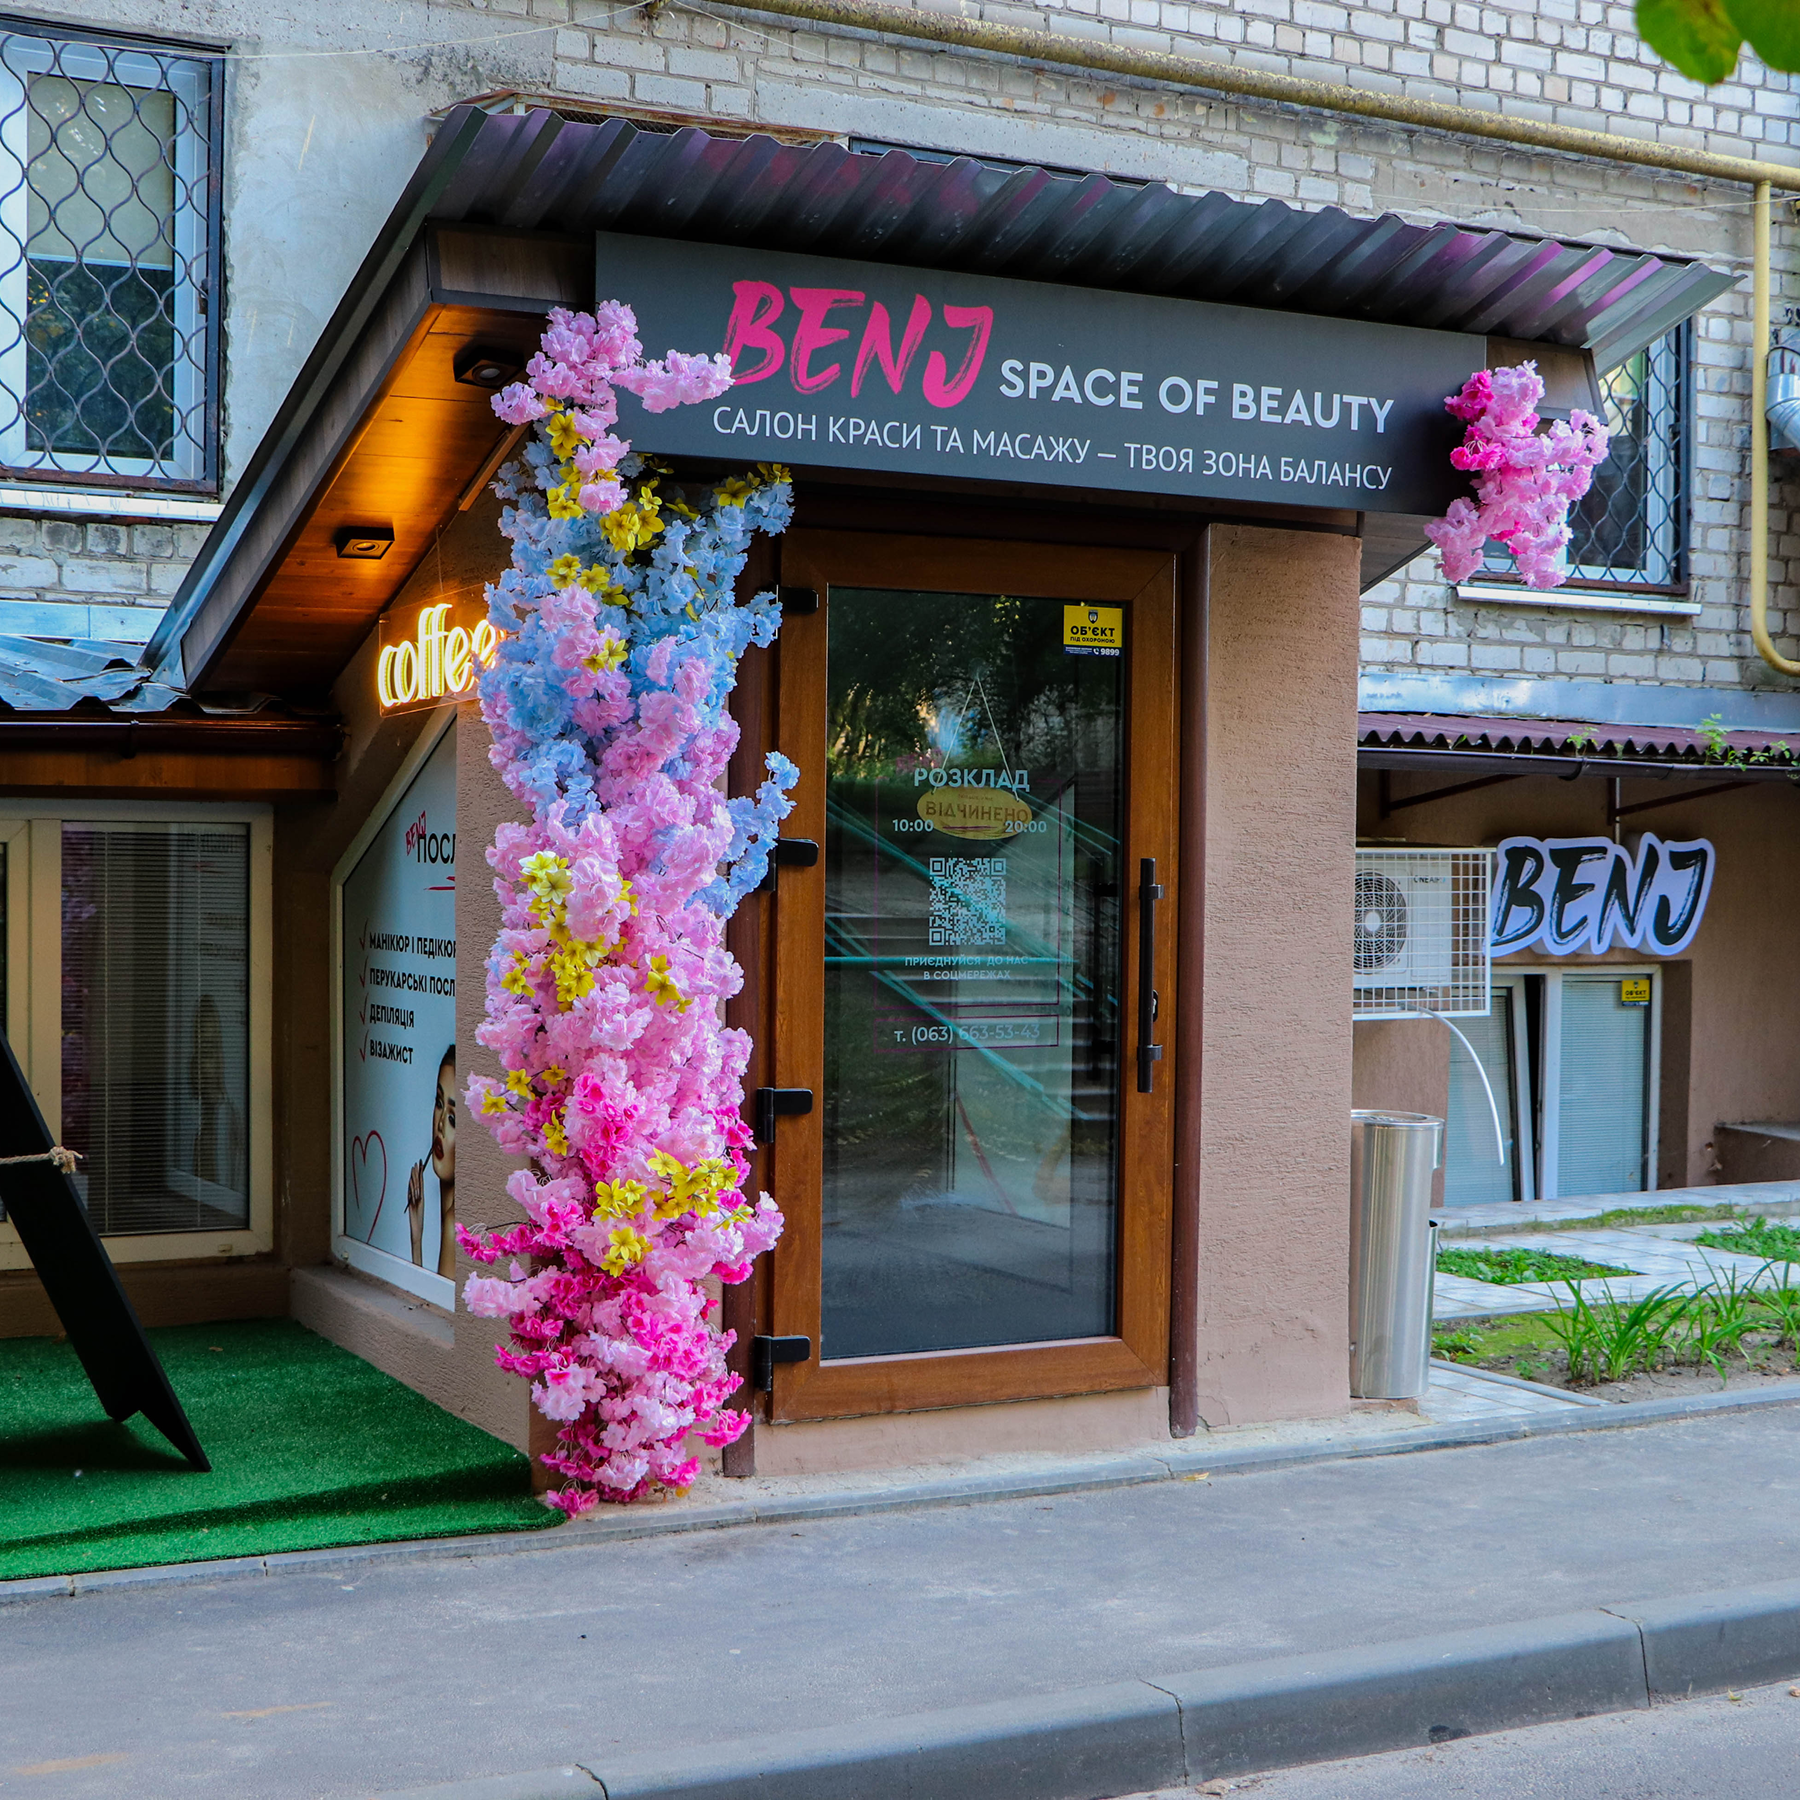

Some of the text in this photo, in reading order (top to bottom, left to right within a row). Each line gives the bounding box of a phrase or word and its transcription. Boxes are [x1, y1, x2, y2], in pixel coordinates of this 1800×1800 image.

[723, 280, 1395, 434] BENJ SPACE OF BEAUTY
[712, 405, 817, 441] САЛОН
[828, 415, 922, 451] КРАСИ
[929, 424, 965, 454] ТА
[972, 428, 1091, 464] МАСАЖУ
[1124, 441, 1194, 473] ТВОЯ
[1203, 449, 1273, 481] ЗОНА
[1280, 456, 1393, 490] БАЛАНСУ
[1070, 625, 1116, 638] ОБ'ЄКТ
[377, 603, 498, 707] coffee
[1100, 647, 1121, 656] 9899
[914, 767, 1030, 793] РОЗКЛАД
[925, 800, 1029, 823] ВІДЧИНЕНО
[892, 819, 1048, 834] 10:00 20:00
[1491, 843, 1708, 946] BENJ
[369, 932, 410, 953] МАНІКЮР
[904, 954, 1029, 967] ПРИЄДНУЙСЯ ДО НАС
[369, 967, 427, 992] ПЕРУКАРСЬКІ
[923, 970, 1011, 981] В СОЦМЕРЕЖАХ
[369, 1003, 414, 1029] ДЕПІЛЯЦІЯ
[911, 1025, 954, 1046] (063)
[958, 1024, 1041, 1040] 663-53-43
[369, 1038, 414, 1065] ВІЗАЖИСТ
